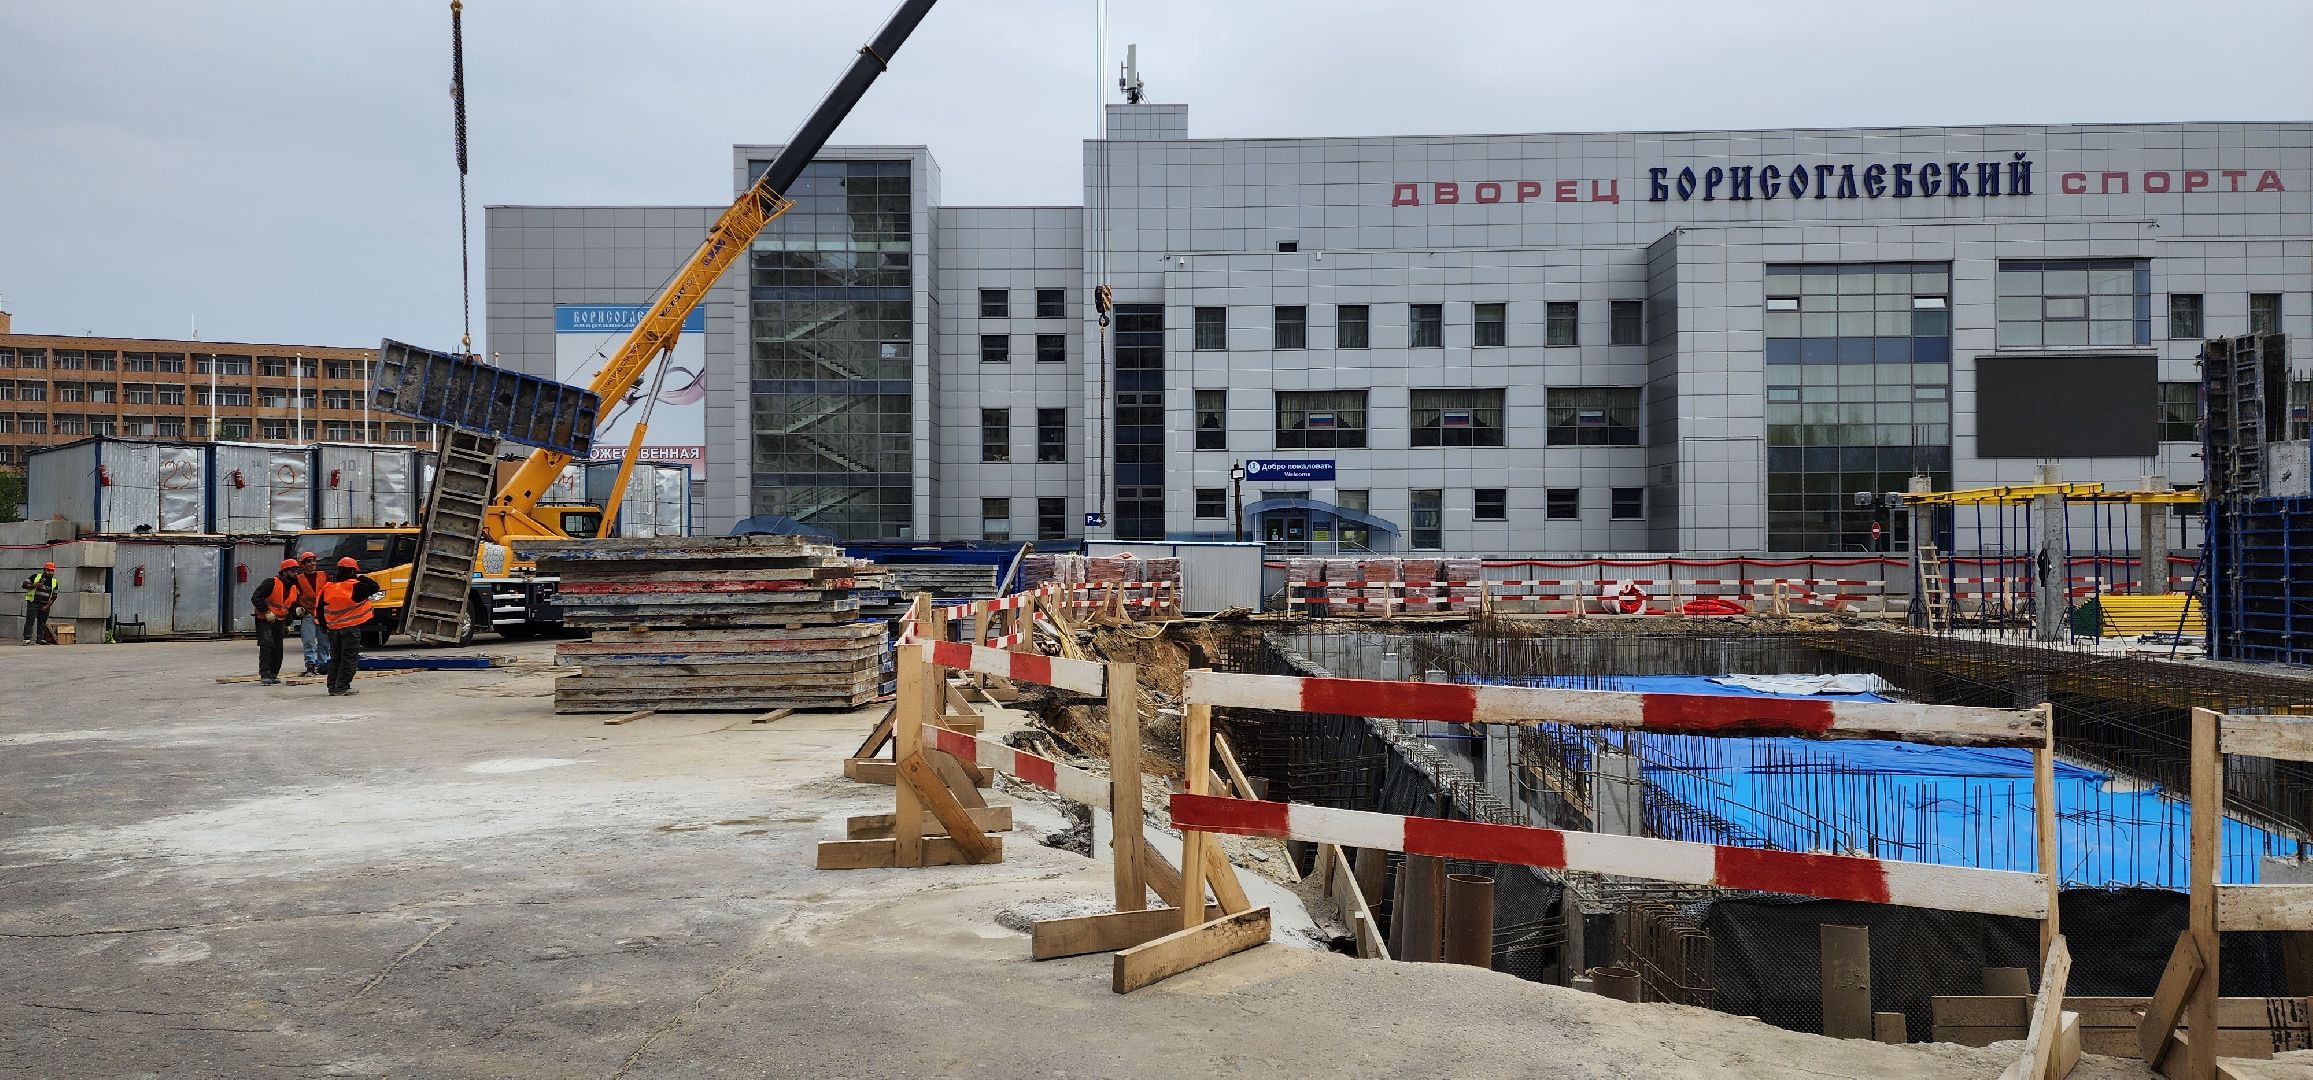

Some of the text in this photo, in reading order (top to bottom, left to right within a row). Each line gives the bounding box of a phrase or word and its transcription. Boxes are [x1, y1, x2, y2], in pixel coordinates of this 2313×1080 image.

[1391, 151, 2286, 207] ДВОРЕЦ БОРИСОГЛЕБСКИЙ СПОРТА
[590, 447, 700, 459] ОЖЕСВЕННАЯ
[1261, 463, 1286, 471] Добро
[1087, 515, 1094, 524] P
